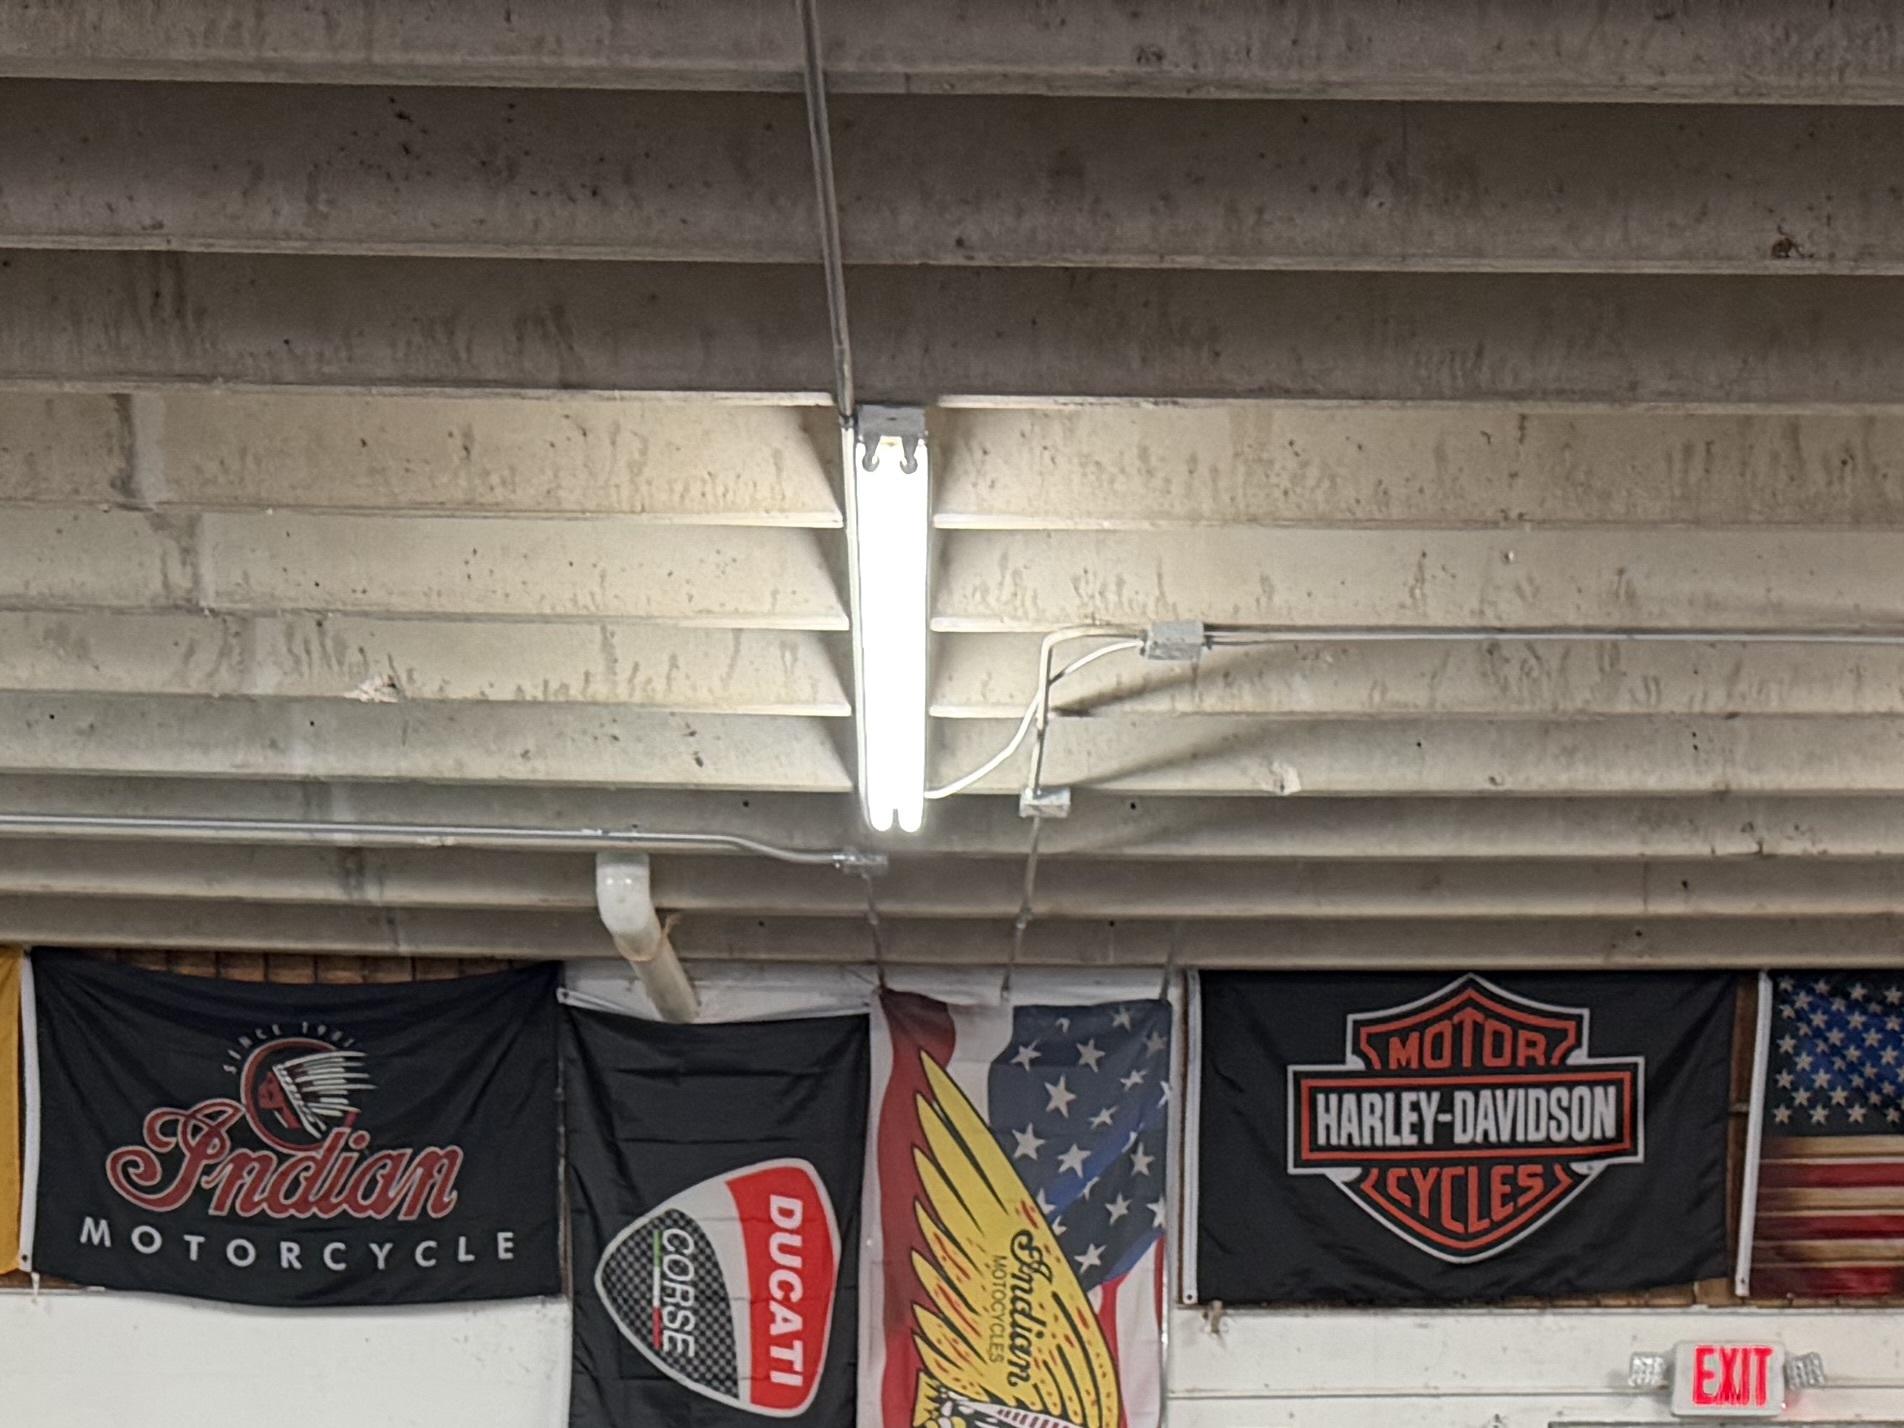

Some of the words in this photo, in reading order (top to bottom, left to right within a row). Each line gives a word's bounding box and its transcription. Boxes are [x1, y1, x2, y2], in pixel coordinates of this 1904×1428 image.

[1389, 1006, 1548, 1070] MOTOR
[106, 1097, 464, 1221] Indian
[1316, 1085, 1617, 1147] HARLEY-DAVIDSON
[79, 1216, 515, 1271] MOTORCYCLE
[1386, 1163, 1545, 1235] CYCLES
[662, 1227, 696, 1358] CORSE
[769, 1194, 803, 1388] DUCATI
[988, 1254, 1008, 1364] MOTOCYCLES
[1006, 1229, 1053, 1388] Indian
[1692, 1345, 1774, 1407] EXIT
